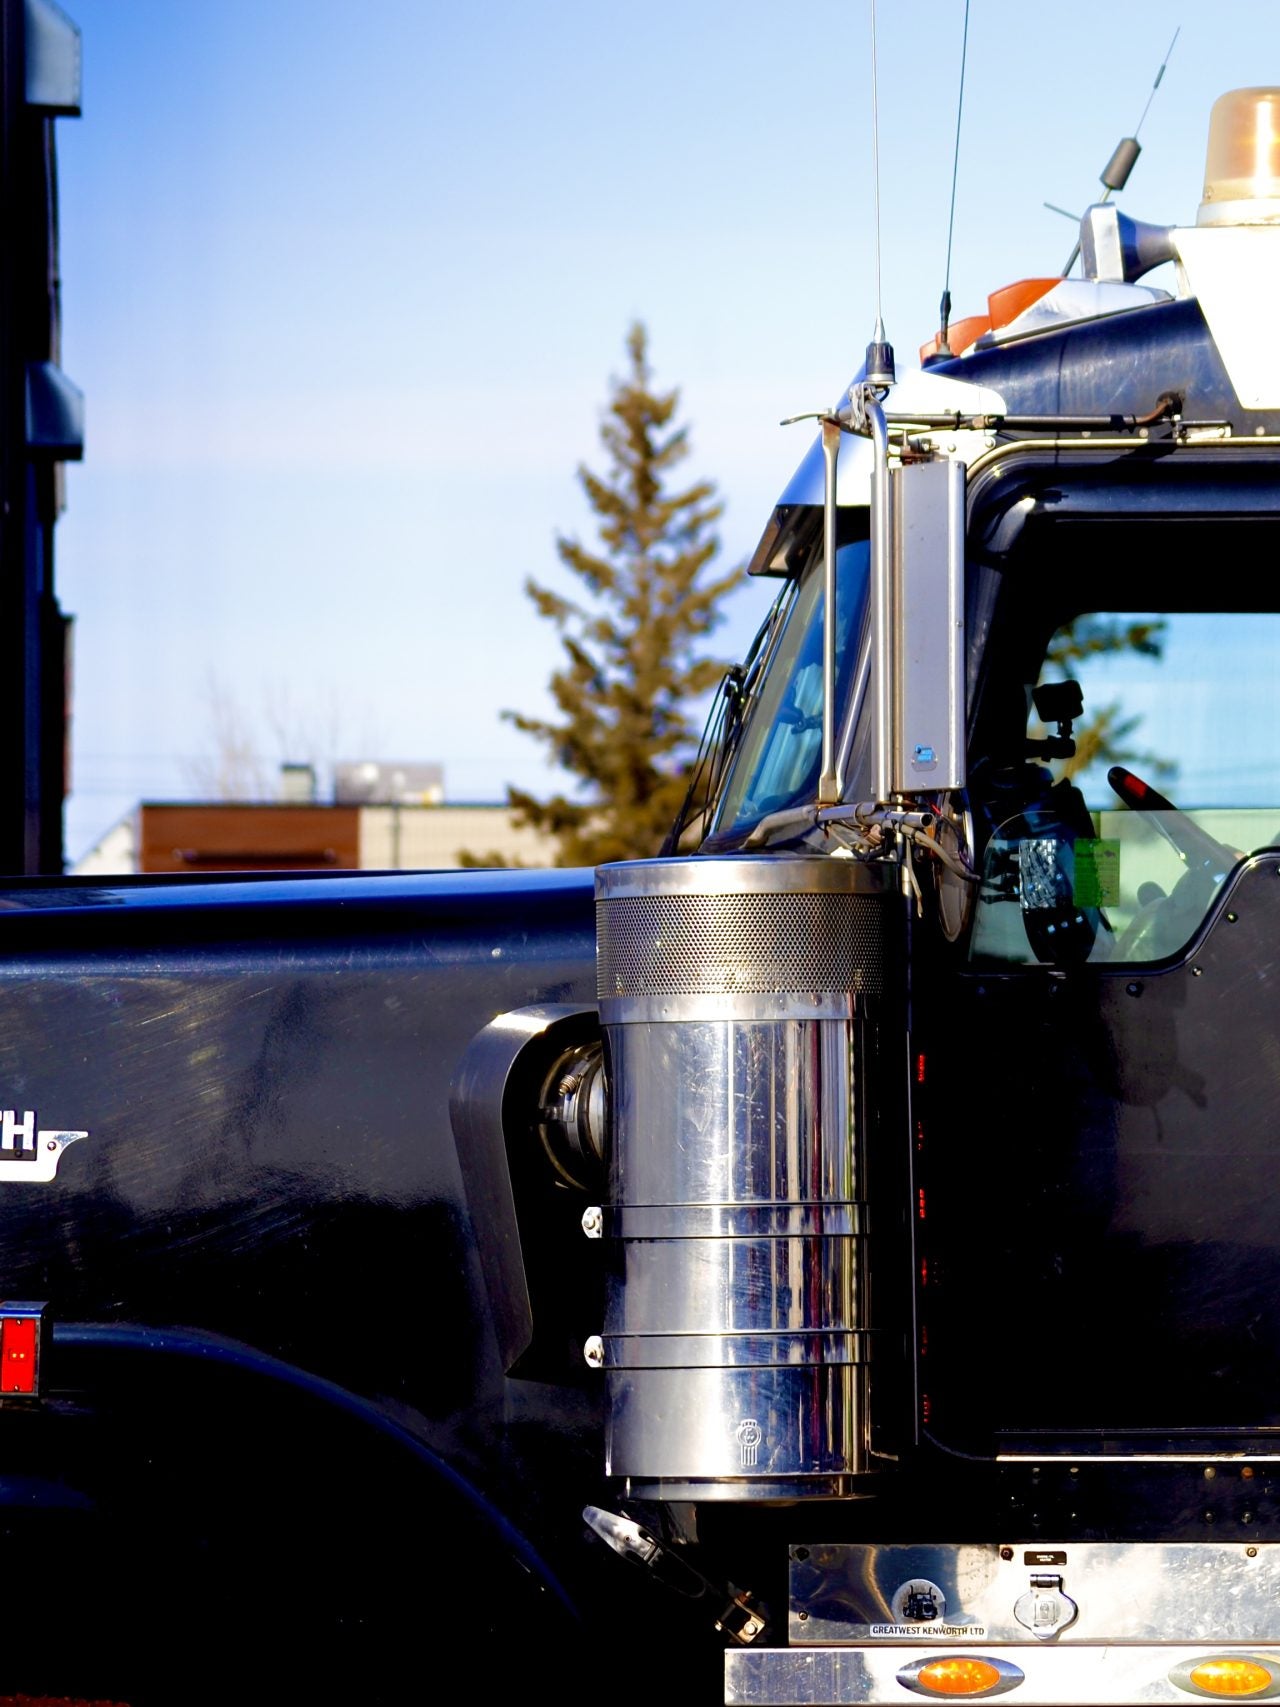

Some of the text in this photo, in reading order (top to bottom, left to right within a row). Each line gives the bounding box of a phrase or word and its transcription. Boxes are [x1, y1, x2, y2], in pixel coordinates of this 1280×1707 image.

[0, 1110, 35, 1150] H
[872, 1625, 985, 1636] GREATWEST KENWORTH LTD
